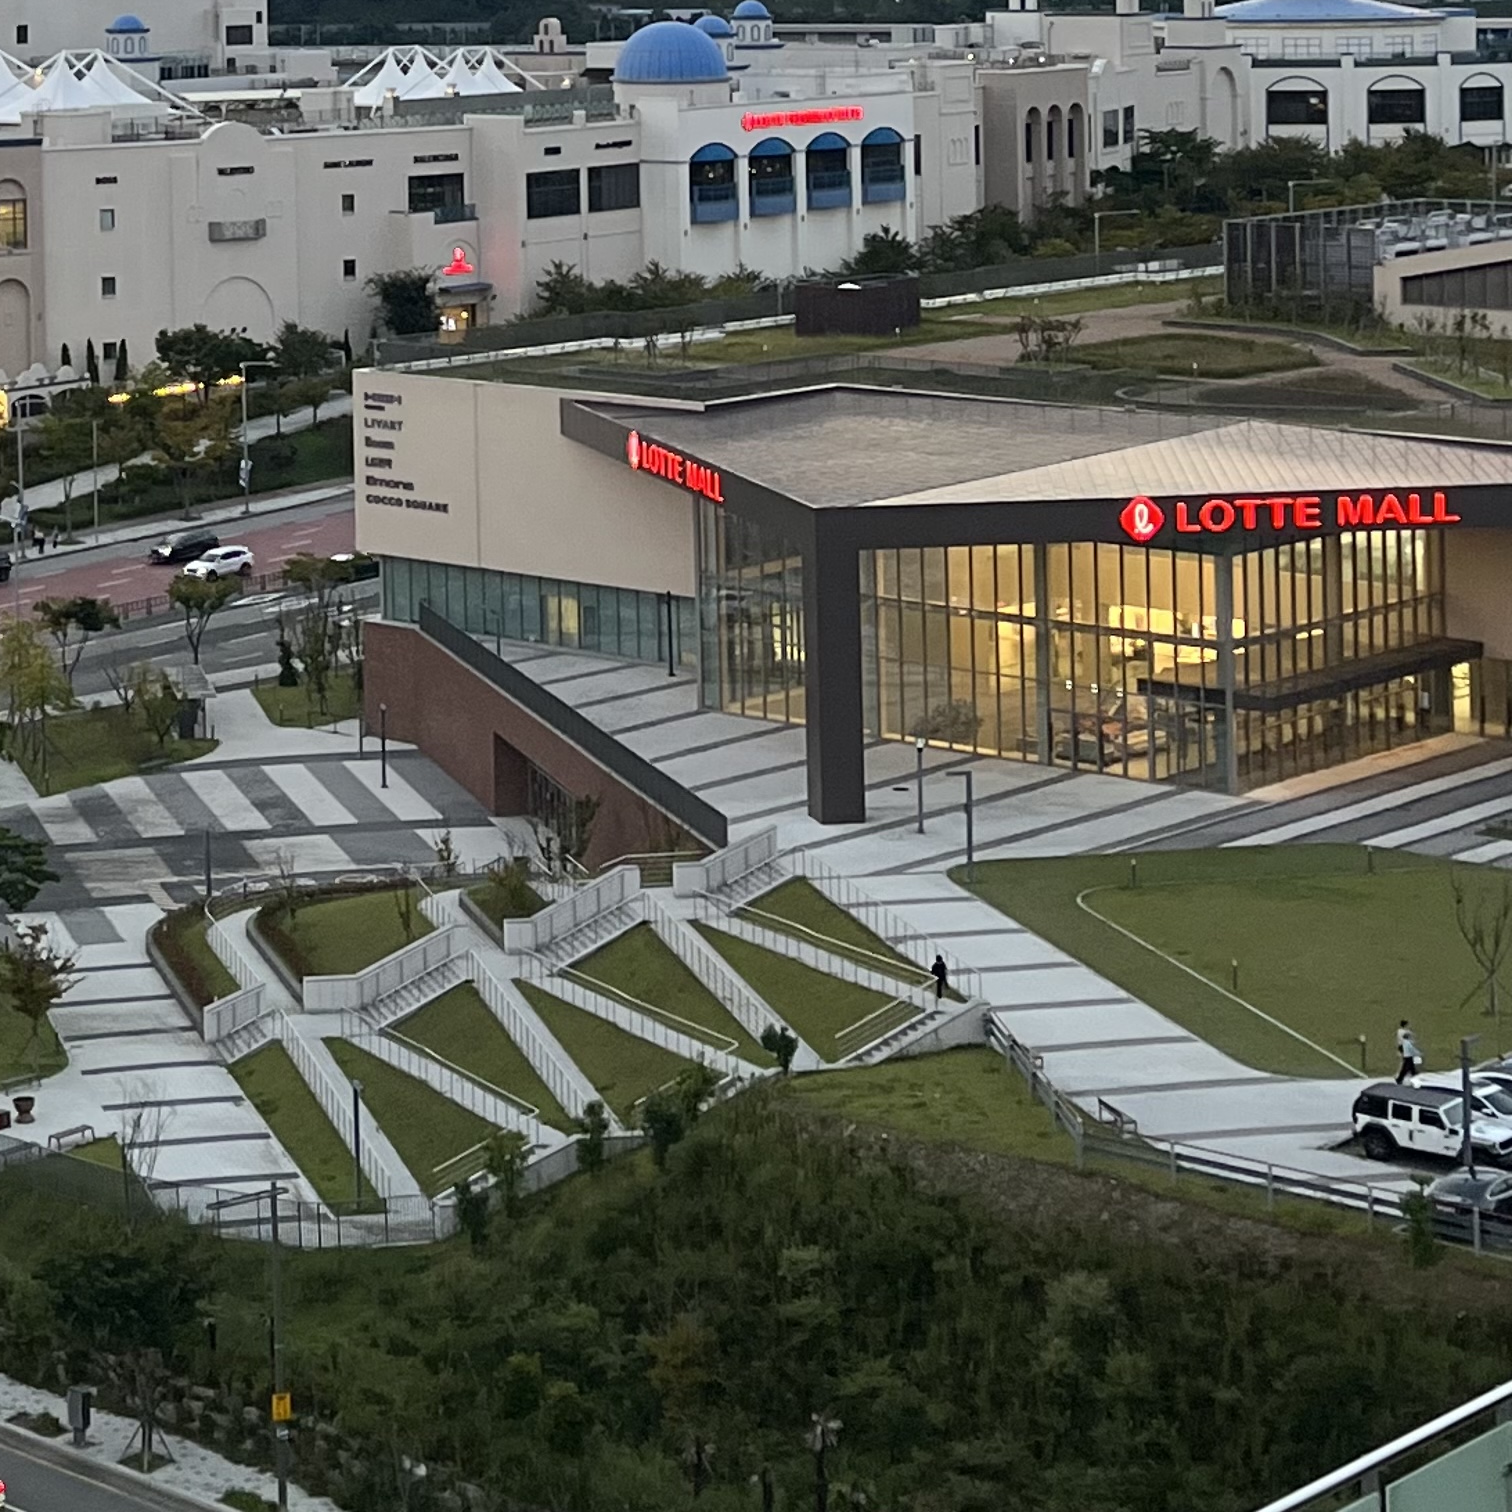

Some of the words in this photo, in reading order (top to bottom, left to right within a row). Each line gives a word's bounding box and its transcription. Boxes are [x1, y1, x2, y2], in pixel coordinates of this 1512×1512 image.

[641, 440, 684, 485] LOTTE
[685, 459, 725, 503] MALL
[1175, 496, 1323, 534] LOTTE
[1337, 491, 1462, 527] MALL
